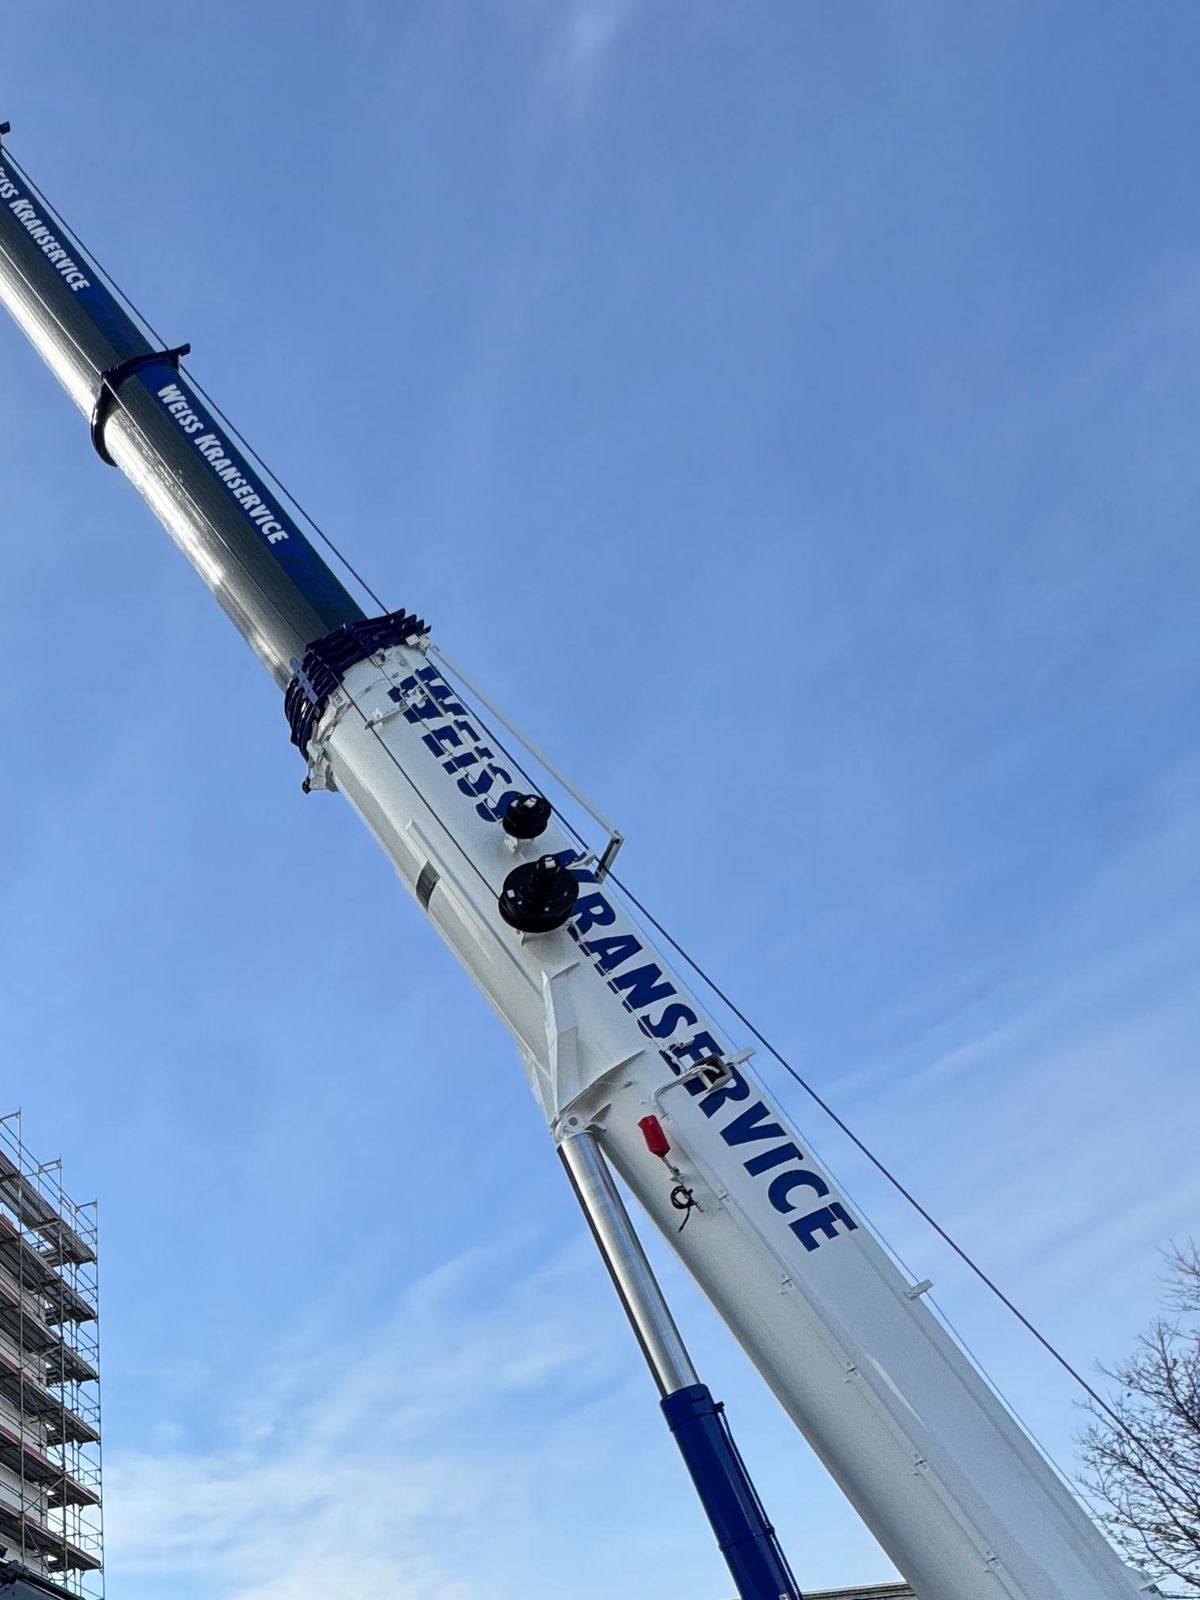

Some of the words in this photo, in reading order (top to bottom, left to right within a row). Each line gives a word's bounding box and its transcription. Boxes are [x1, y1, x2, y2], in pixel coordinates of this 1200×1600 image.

[8, 198, 90, 291] KRANSERVICE
[157, 383, 204, 434] WEISS
[194, 433, 289, 545] KRANSERVICE
